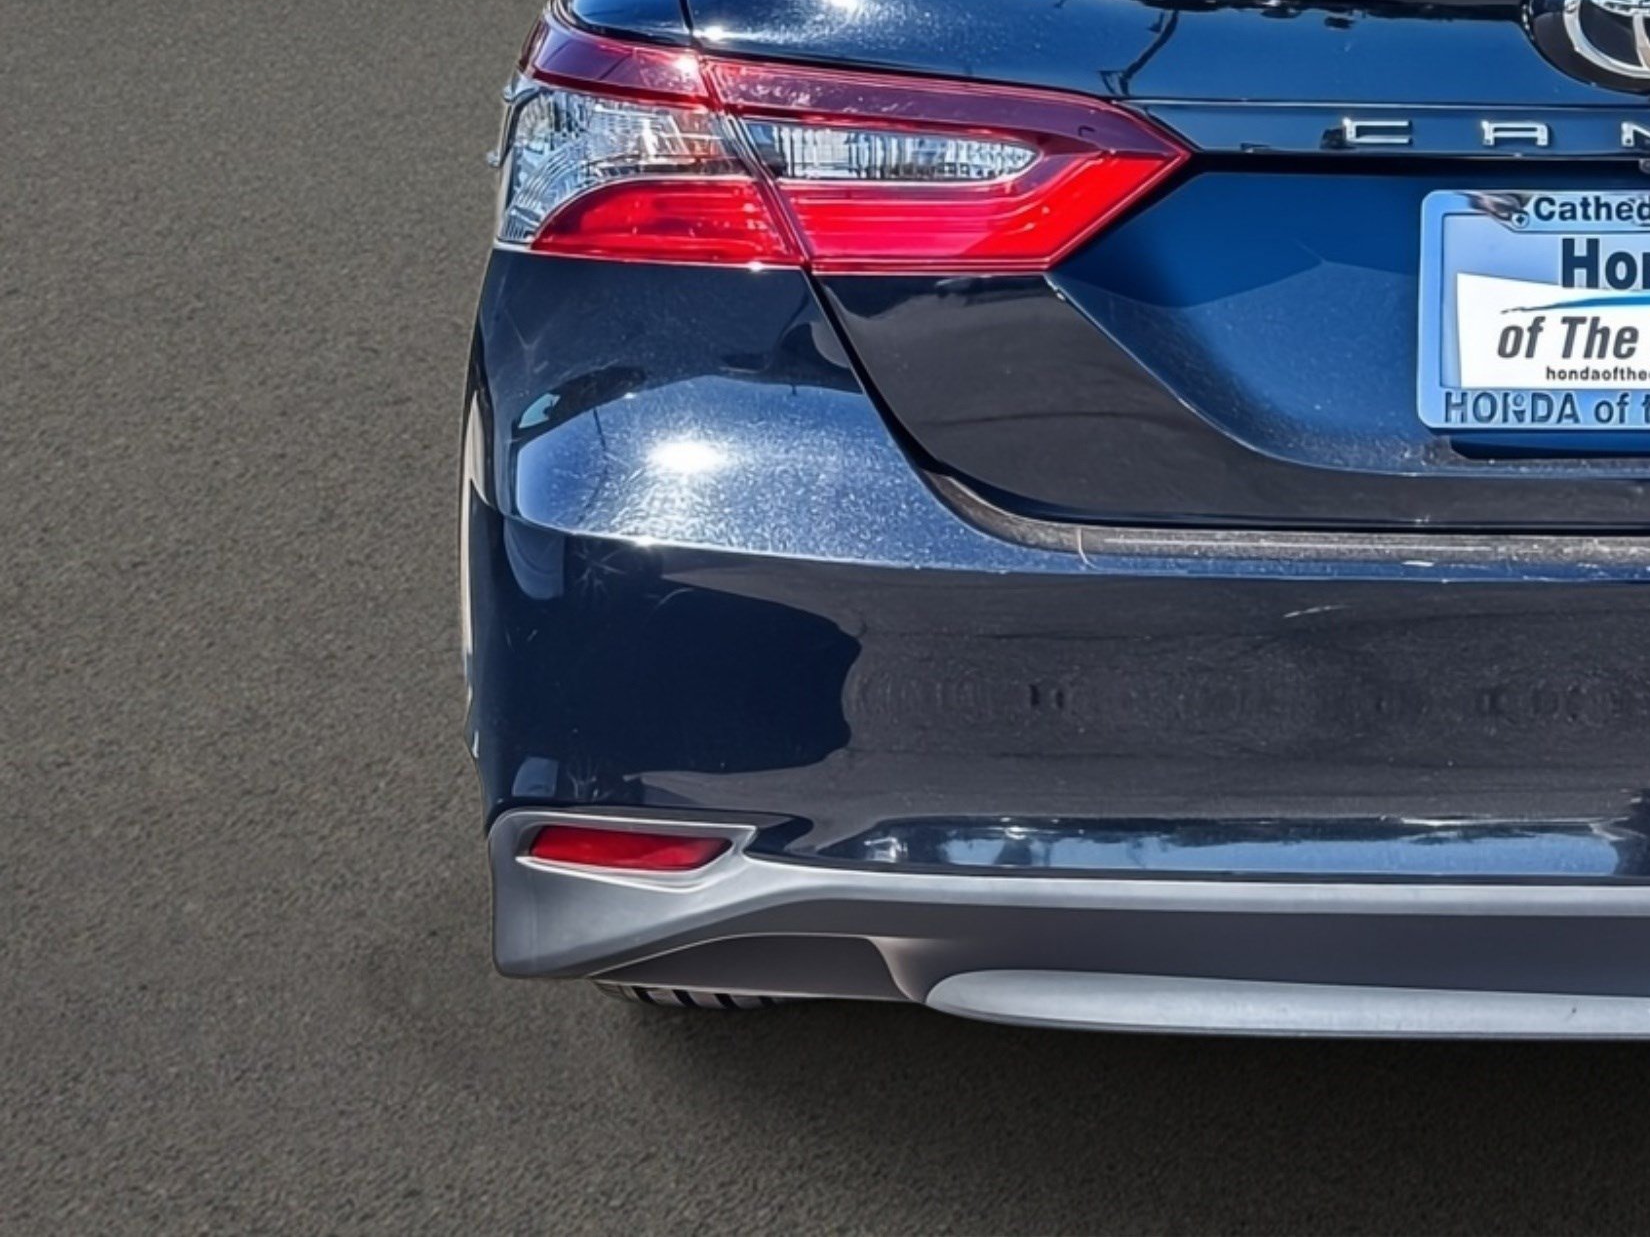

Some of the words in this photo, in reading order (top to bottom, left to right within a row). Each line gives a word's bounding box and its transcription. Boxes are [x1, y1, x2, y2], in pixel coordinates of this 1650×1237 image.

[1497, 315, 1546, 359] of
[1560, 316, 1639, 360] The
[1443, 391, 1576, 425] HONDA
[1594, 391, 1630, 425] of
